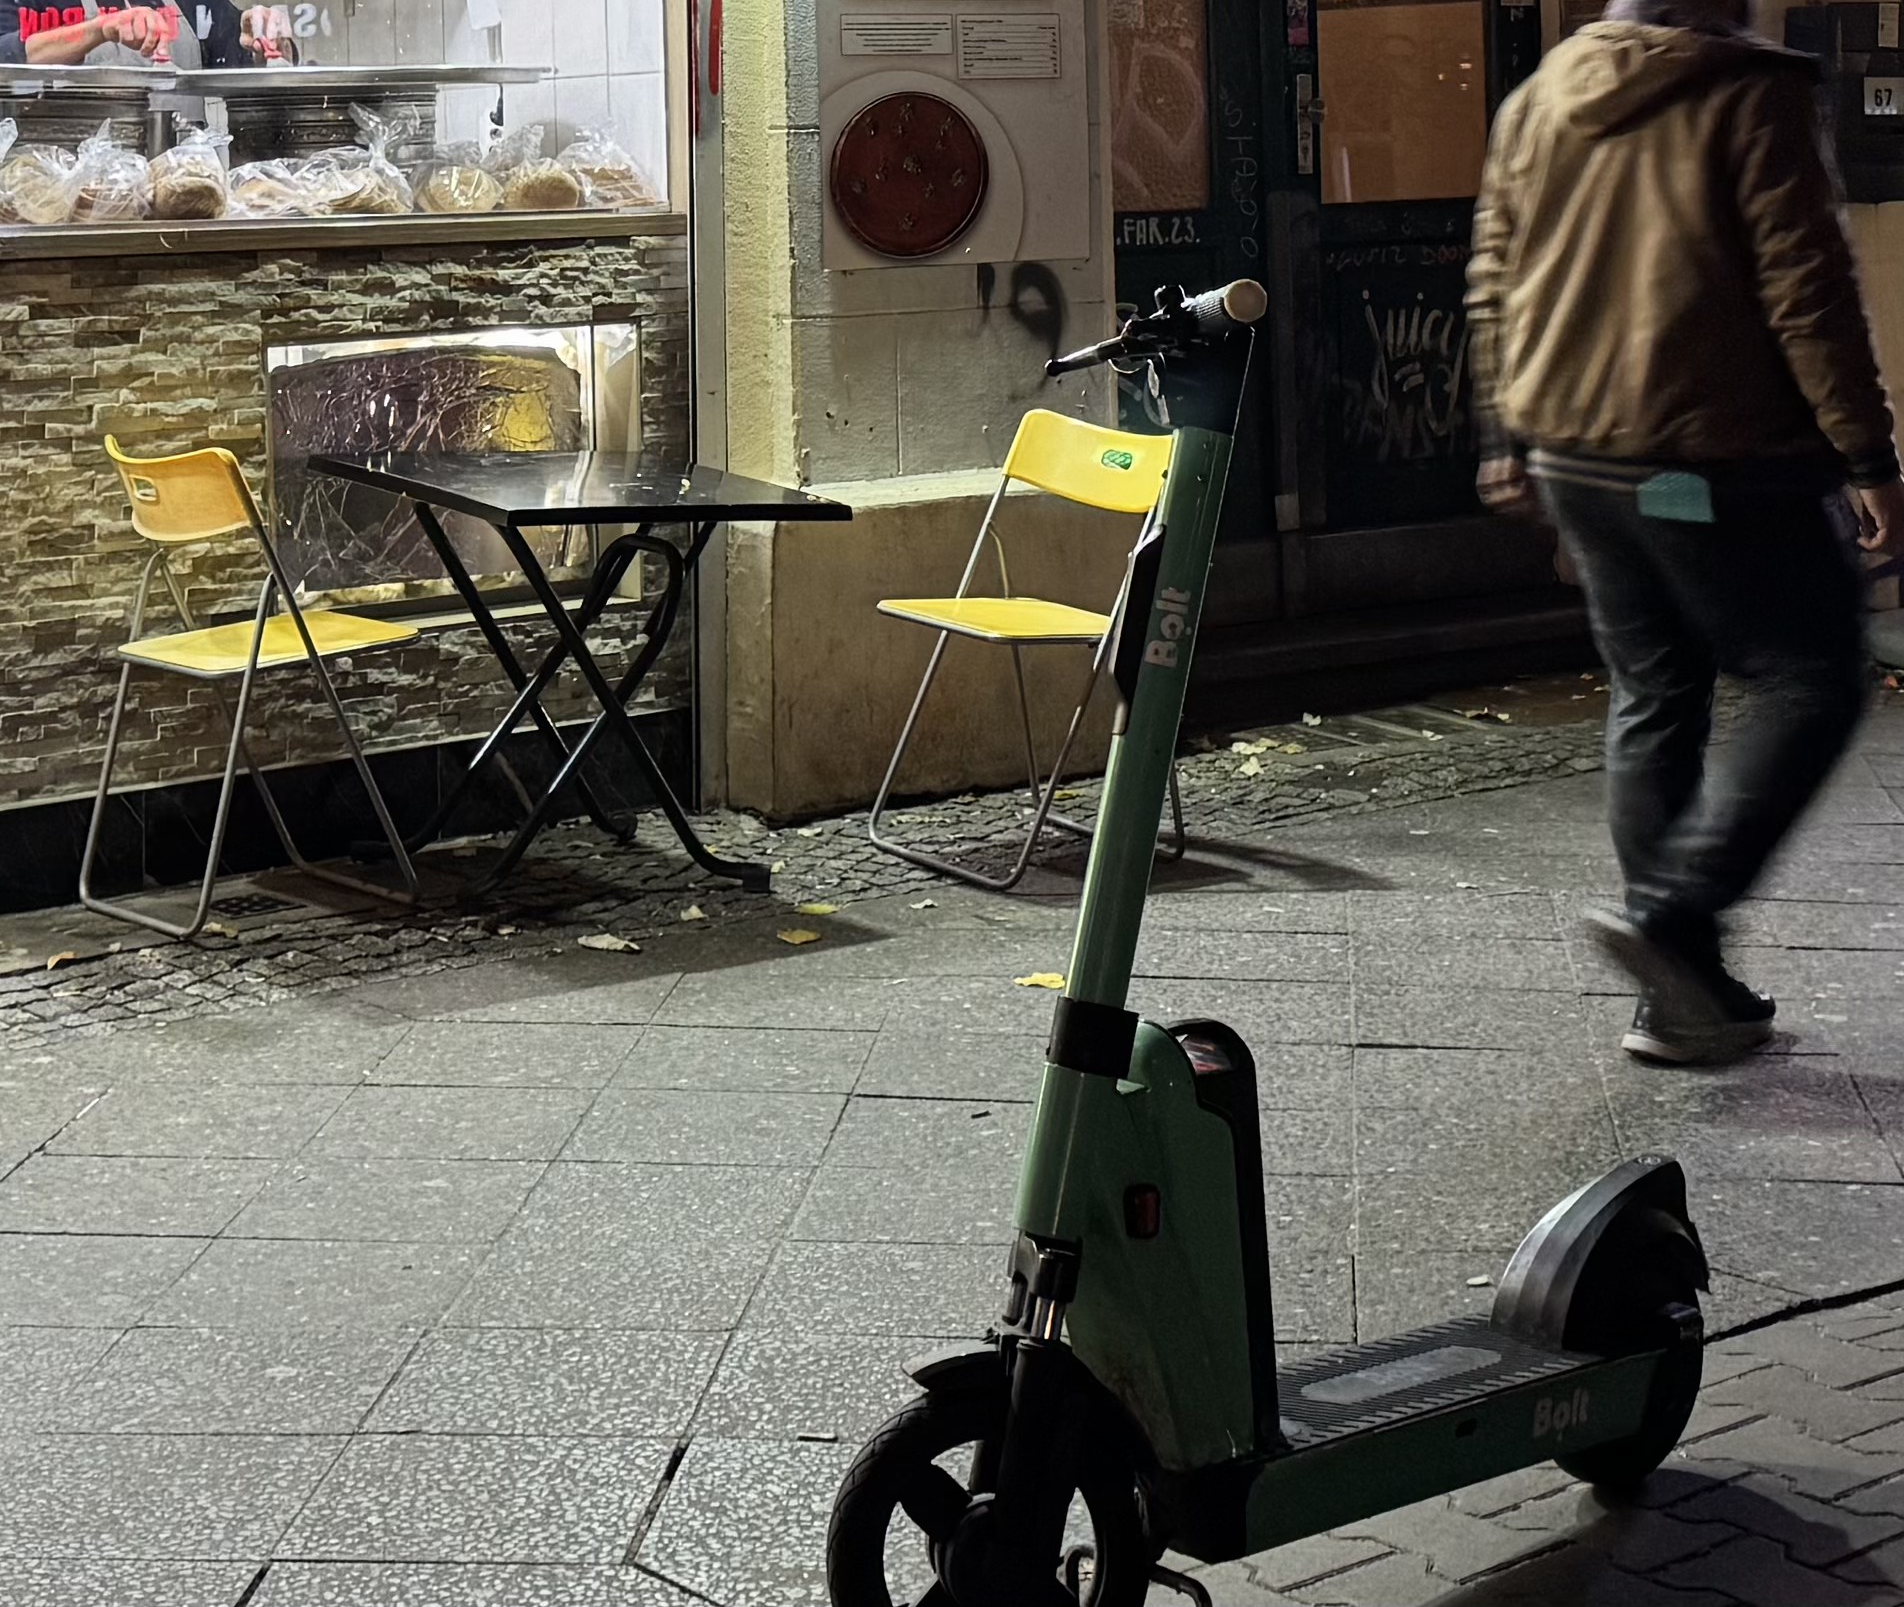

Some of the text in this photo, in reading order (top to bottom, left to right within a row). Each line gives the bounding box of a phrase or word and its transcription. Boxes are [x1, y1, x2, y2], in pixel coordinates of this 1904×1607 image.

[1873, 87, 1894, 108] 67
[1143, 585, 1192, 668] Bolt
[1533, 1384, 1590, 1442] Bolt
